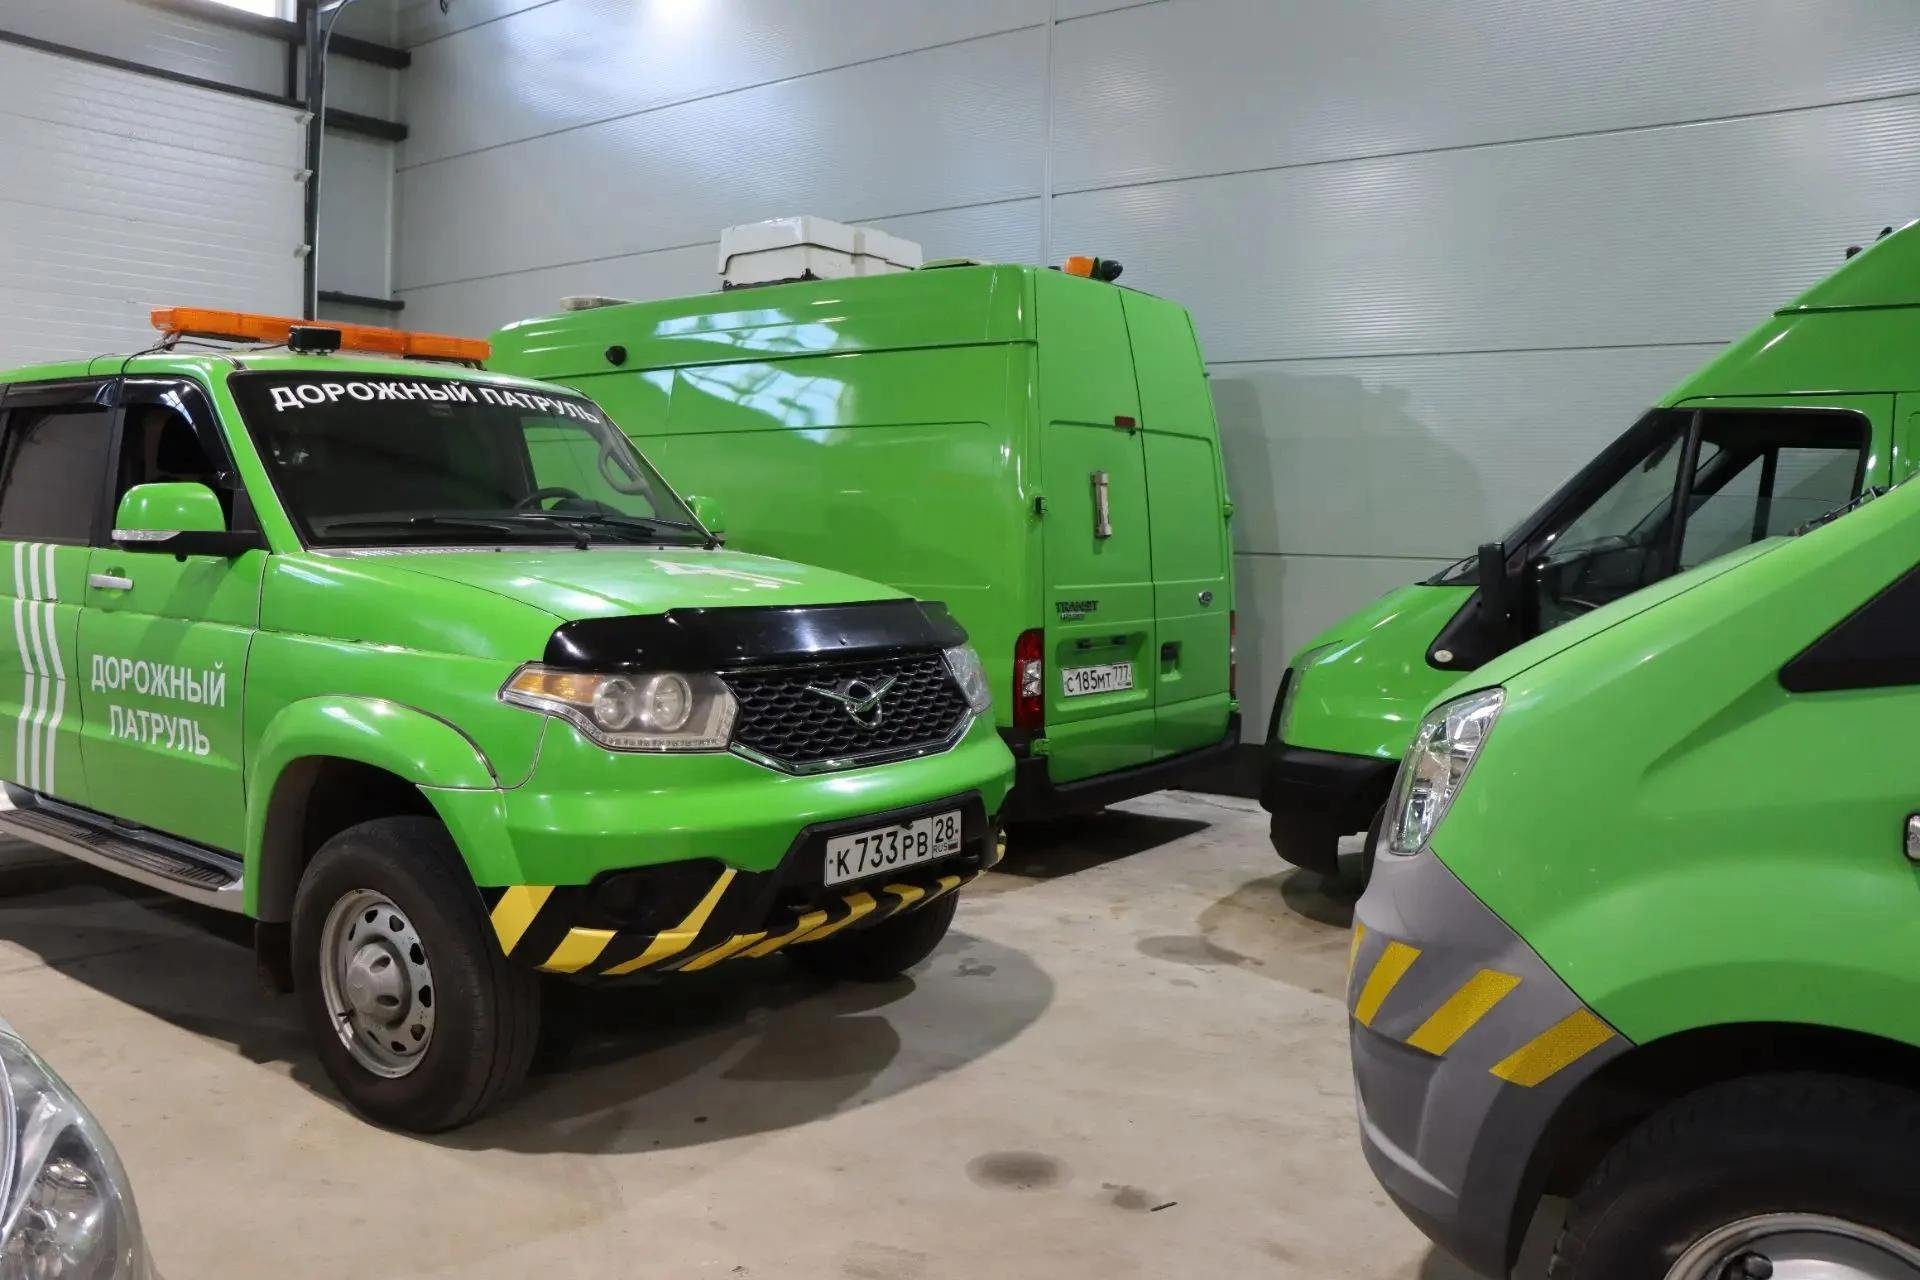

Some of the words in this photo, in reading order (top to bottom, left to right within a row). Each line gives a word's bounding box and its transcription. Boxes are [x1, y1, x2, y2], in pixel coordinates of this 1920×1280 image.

[269, 380, 478, 412] ДОРОЖНЫЙ
[478, 386, 601, 424] ПАТРУЛЬ
[91, 654, 226, 708] ДОРОЖНЫЙ
[1112, 665, 1128, 681] 777
[109, 704, 211, 756] ПАТРУЛЬ
[837, 830, 928, 876] К733РВ
[935, 816, 954, 843] 28
[933, 842, 948, 853] RUS
